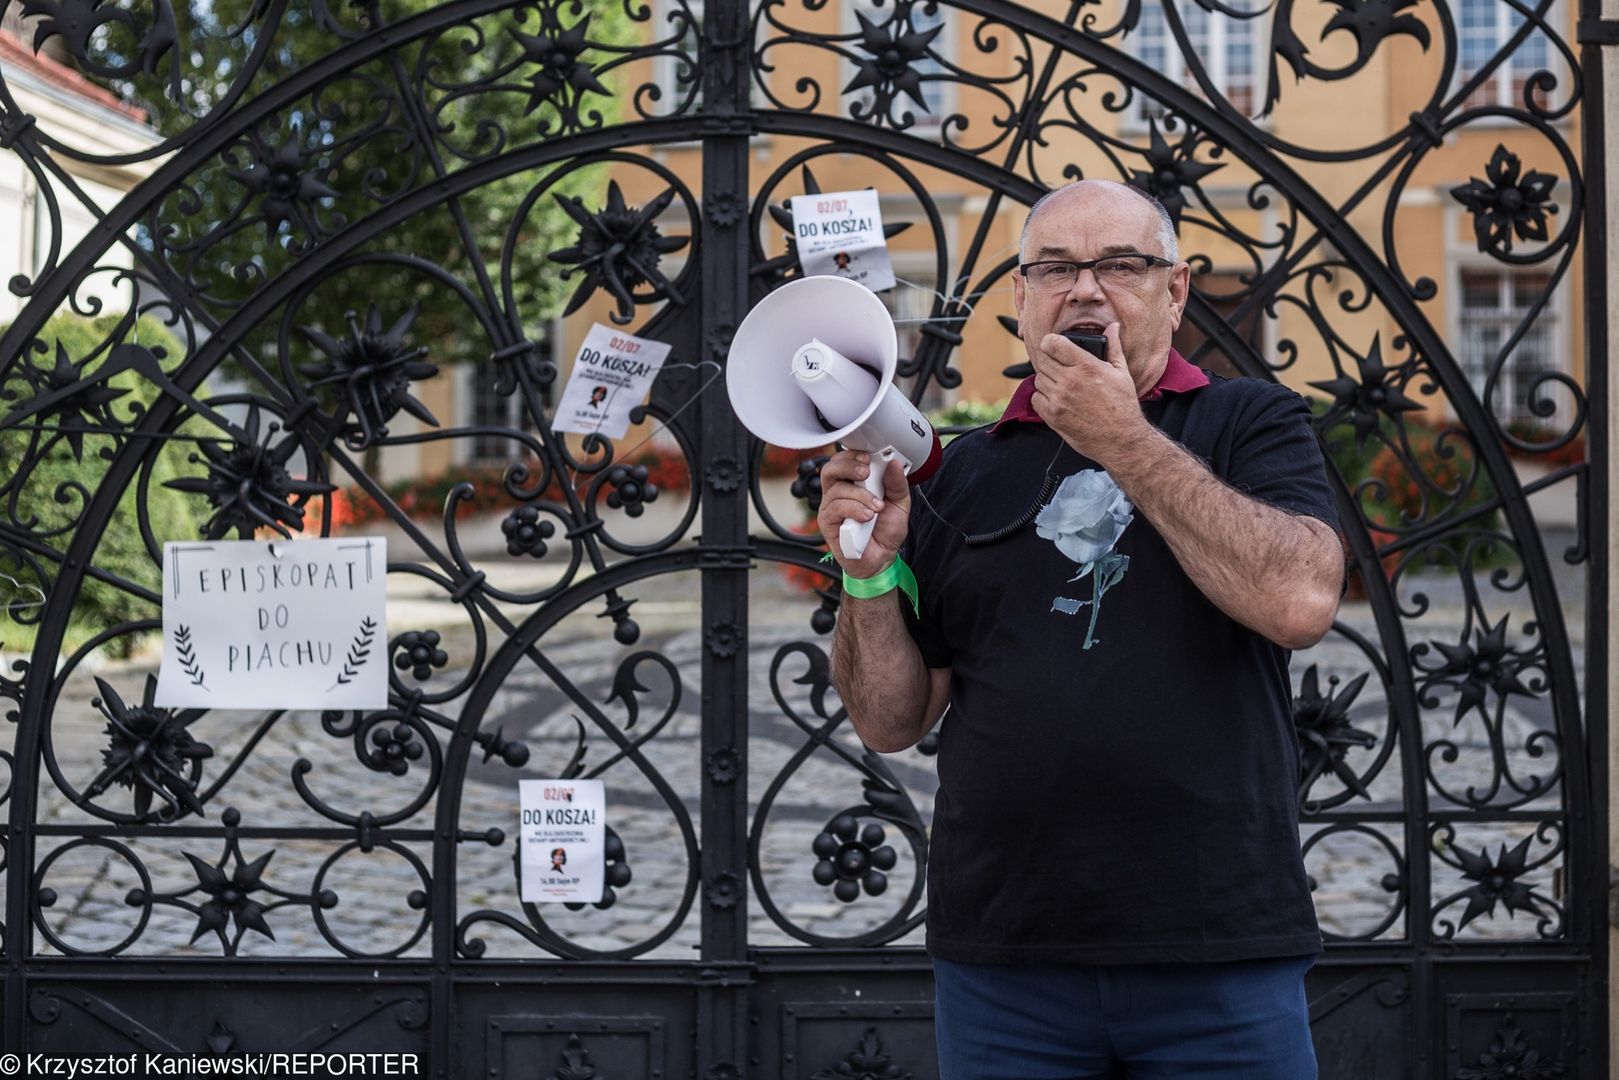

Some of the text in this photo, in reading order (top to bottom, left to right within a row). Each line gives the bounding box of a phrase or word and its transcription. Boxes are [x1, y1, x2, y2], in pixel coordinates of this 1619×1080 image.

[817, 200, 848, 214] 02/07
[799, 218, 873, 238] DO KOSZA!
[609, 336, 641, 354] 02/07
[580, 348, 601, 365] DO
[601, 355, 652, 378] KOSZA!
[199, 562, 356, 593] EPISKOPAT
[258, 604, 289, 631] DO
[229, 640, 332, 672] PIACHU
[523, 809, 596, 825] DO KOSZA!
